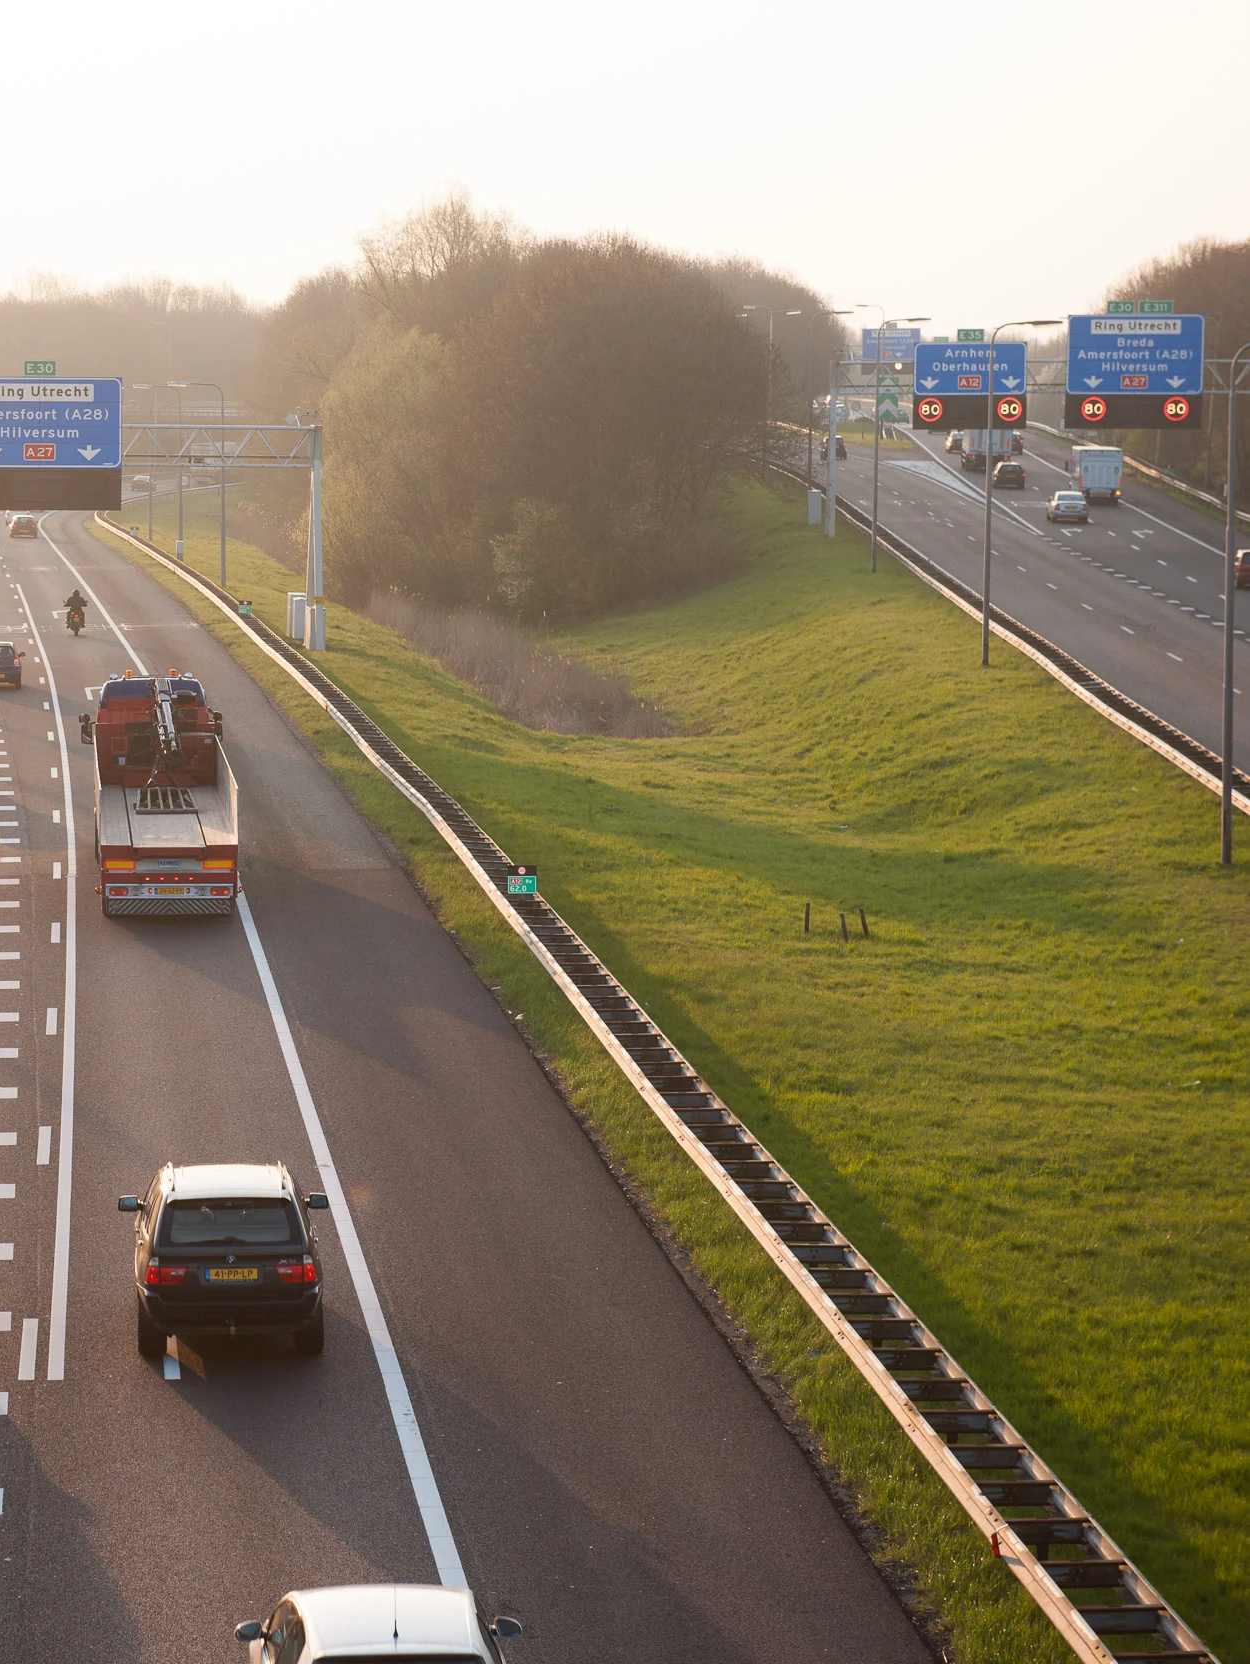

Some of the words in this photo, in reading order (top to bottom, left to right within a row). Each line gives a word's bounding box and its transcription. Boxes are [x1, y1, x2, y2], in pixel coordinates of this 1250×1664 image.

[1095, 321, 1122, 333] Ring
[1128, 321, 1178, 331] Utrecht
[1117, 337, 1154, 347] Breda
[944, 348, 996, 358] Arnhem
[1077, 349, 1150, 359] Amersfoort
[1155, 349, 1193, 360] (A28)
[1101, 361, 1168, 372] Hilversum
[31, 385, 90, 397] Utrecht
[65, 408, 109, 421] (A28)
[921, 404, 940, 416] 80
[1000, 403, 1019, 415] 80
[1083, 403, 1103, 415] 80
[1166, 403, 1187, 415] 80
[0, 426, 79, 438] Hilversum
[214, 1270, 253, 1279] 41-PP-LP
